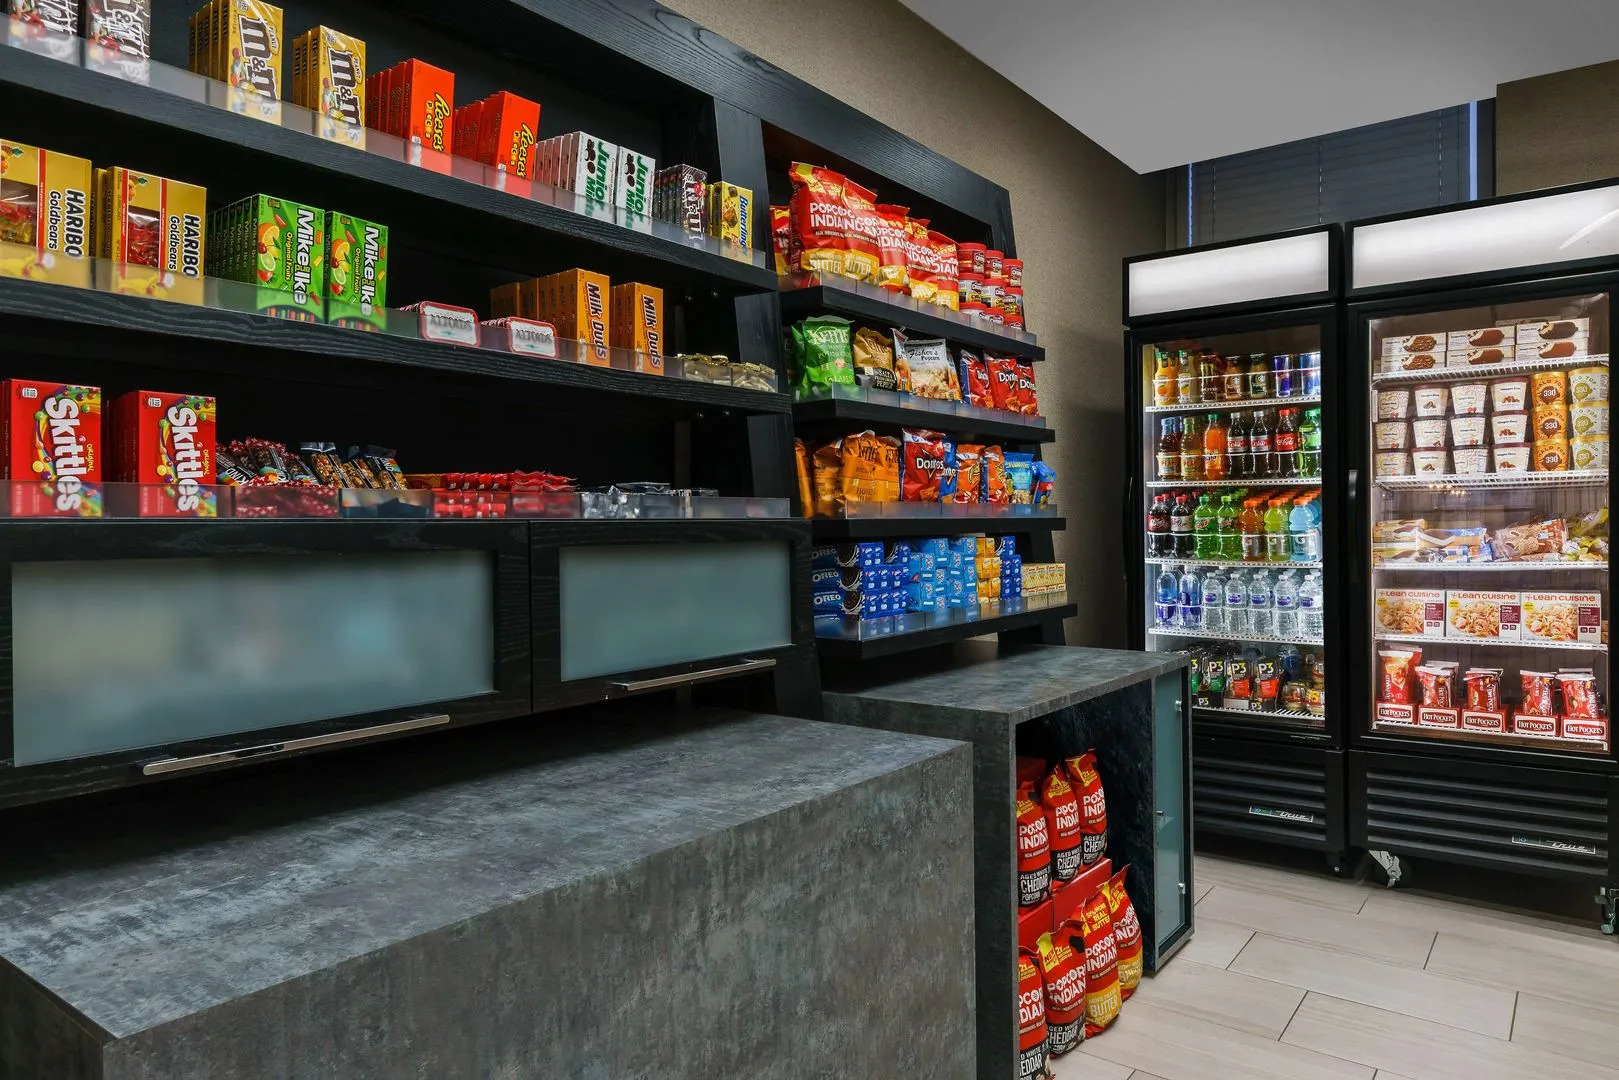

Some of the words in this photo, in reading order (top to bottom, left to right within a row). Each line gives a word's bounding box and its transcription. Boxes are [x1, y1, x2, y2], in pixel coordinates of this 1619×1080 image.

[431, 92, 451, 153] Reese's
[515, 122, 535, 178] Reese's
[47, 190, 62, 250] Goldbears
[64, 188, 86, 259] HARIBO
[167, 214, 181, 271] Goldbears
[181, 213, 201, 279] HARIBO
[285, 231, 294, 263] Original
[296, 208, 316, 267] Mike
[364, 226, 380, 282] Mike
[285, 263, 293, 282] Fruits
[292, 270, 311, 305] Ike
[353, 275, 361, 294] Fruits
[360, 284, 375, 316] Ike
[586, 281, 604, 319] Milk
[643, 293, 658, 330] Milk
[591, 320, 608, 360] Duds
[646, 329, 661, 369] Duds
[908, 348, 939, 359] Fisher's
[1543, 389, 1556, 397] 330
[44, 396, 89, 512] Skittles
[167, 405, 205, 512] Skittles
[916, 457, 944, 470] Doritos
[225, 467, 249, 486] KIND
[811, 547, 838, 560] OREO
[812, 570, 840, 582] OREO
[813, 593, 841, 606] OREO
[1385, 590, 1408, 598] Lean
[1458, 592, 1482, 600] Lean
[1532, 594, 1557, 602] Lean
[1209, 661, 1224, 672] P3
[1231, 662, 1247, 674] P3
[1258, 662, 1274, 674] P3
[1198, 697, 1209, 706] P3
[1250, 702, 1262, 710] P3
[1379, 708, 1391, 717] HOT
[1390, 709, 1411, 719] POCKETS
[1423, 712, 1434, 721] HOT
[1433, 713, 1455, 722] POCKETS
[1466, 716, 1477, 726] HOT
[1476, 718, 1500, 728] POCKETS
[1518, 719, 1530, 729] HOT
[1530, 721, 1553, 731] POCKETS
[1567, 724, 1579, 734] HOT
[1579, 726, 1603, 735] POCKETS
[1093, 910, 1108, 922] REAL
[1090, 995, 1118, 1018] BUTTER
[1049, 1025, 1078, 1045] HEDDAR
